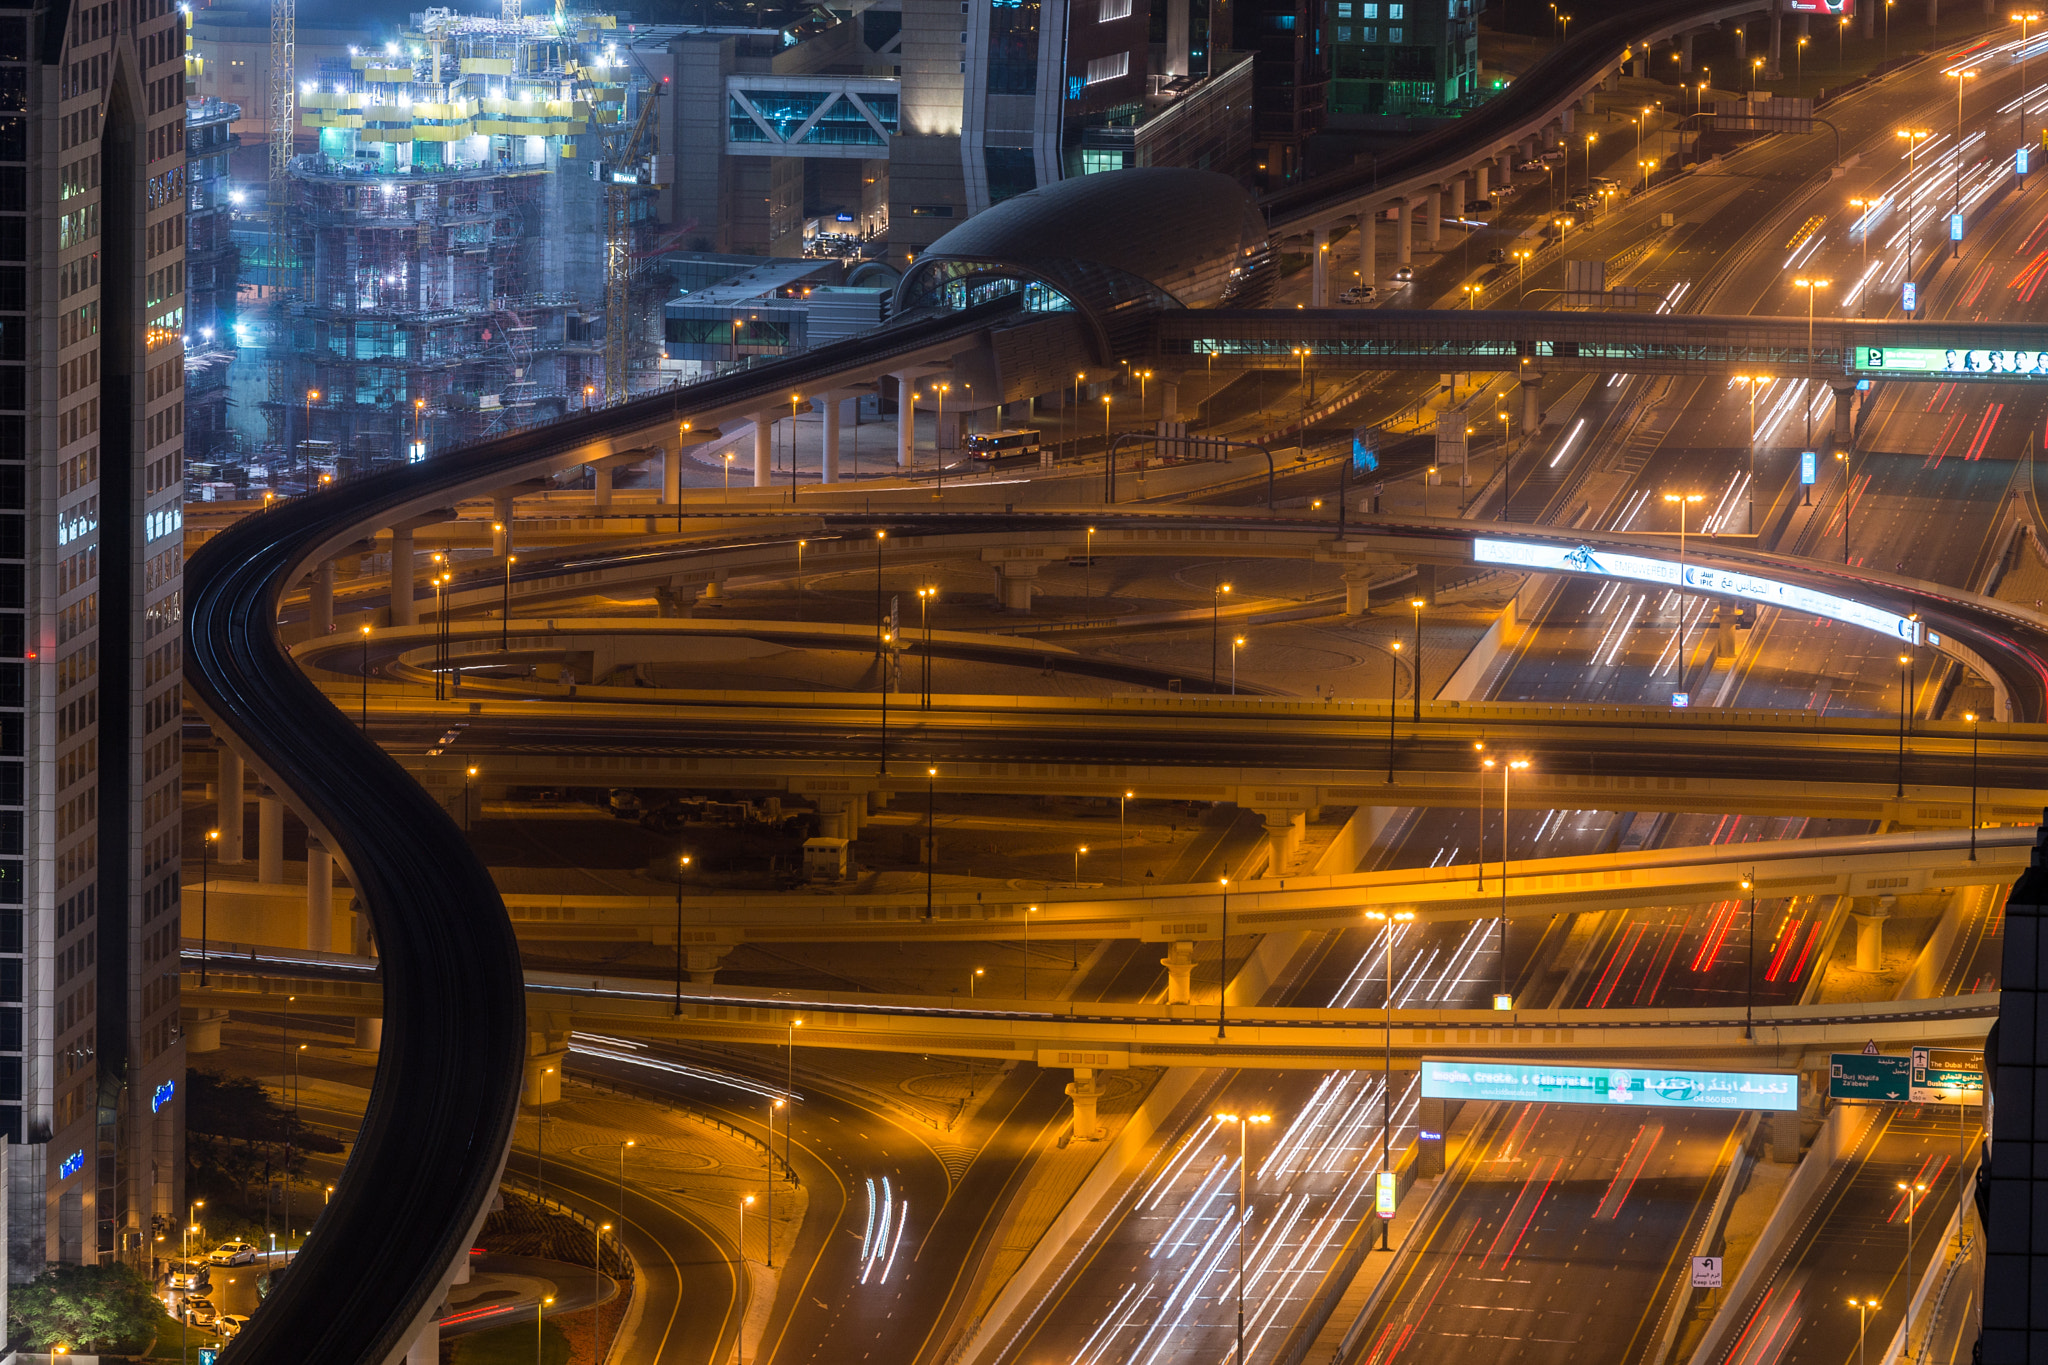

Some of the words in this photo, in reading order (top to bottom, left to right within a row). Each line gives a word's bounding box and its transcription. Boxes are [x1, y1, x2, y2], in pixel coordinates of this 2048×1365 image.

[1481, 543, 1535, 562] PASSION
[1614, 560, 1667, 577] EMPOWERED
[1668, 565, 1680, 578] BY
[1700, 579, 1713, 587] IPIC
[1944, 1061, 1963, 1069] Dubai
